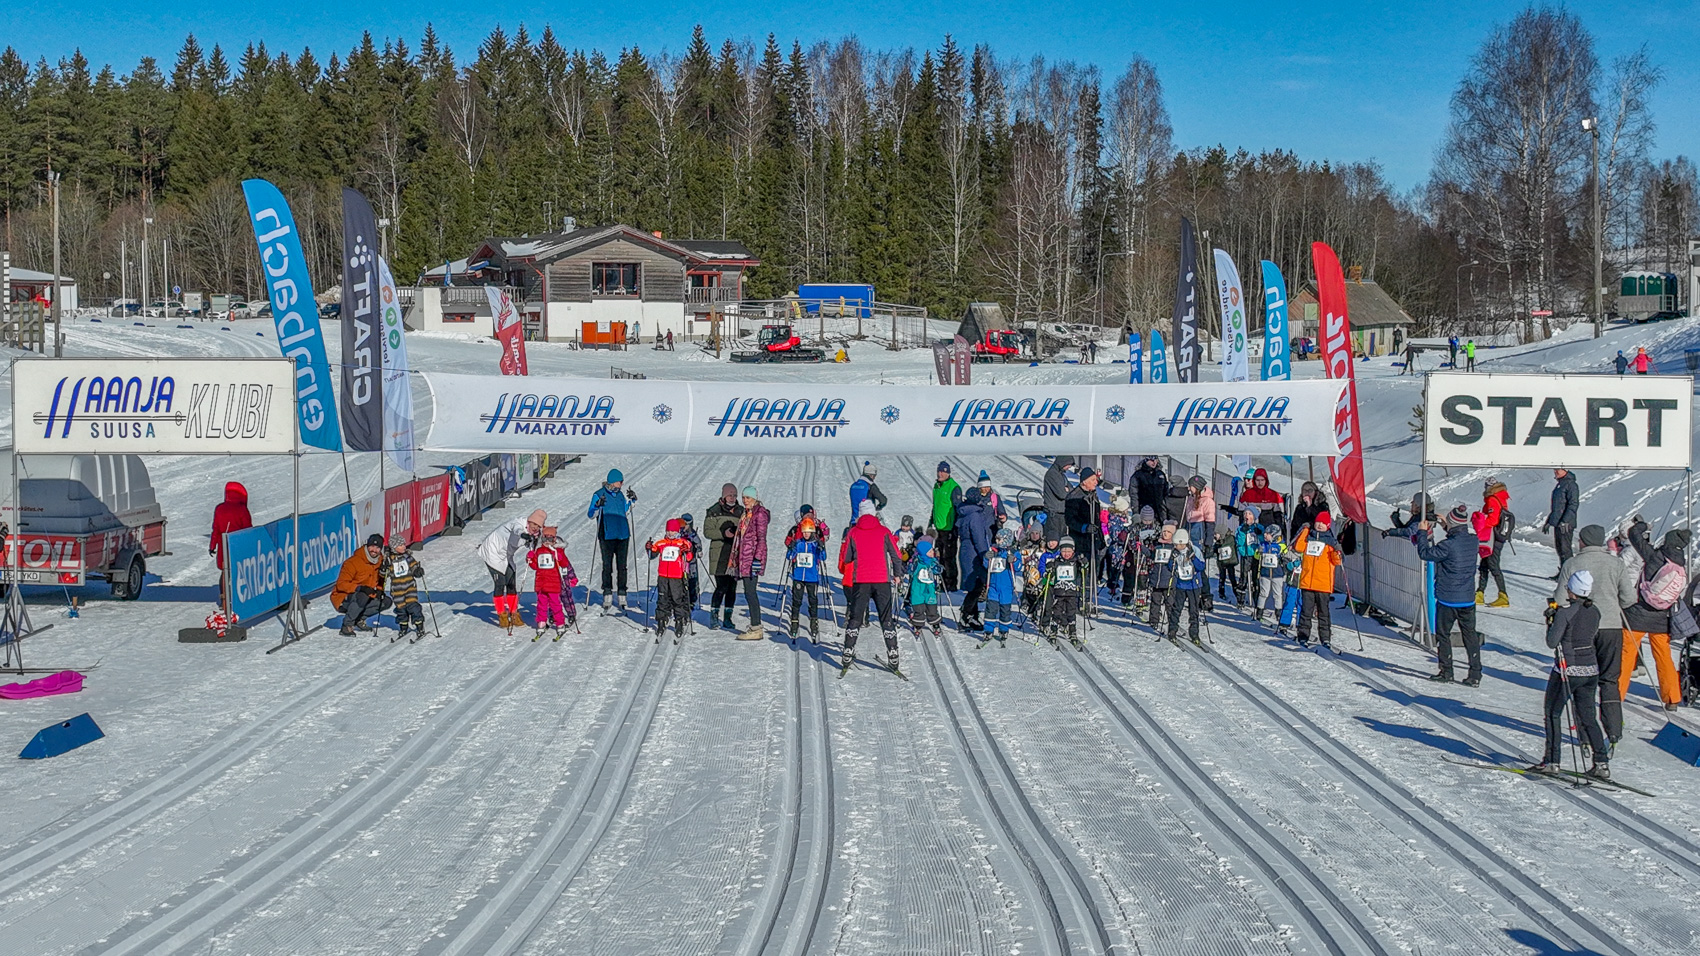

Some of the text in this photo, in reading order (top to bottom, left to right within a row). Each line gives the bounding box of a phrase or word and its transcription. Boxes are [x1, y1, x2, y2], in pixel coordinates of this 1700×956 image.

[44, 376, 273, 439] HAANJA KLUBI
[486, 393, 615, 434] HAANJA
[714, 397, 846, 437] HAANJA
[941, 397, 1071, 437] HAANJA
[1166, 396, 1291, 437] HAANJA
[1439, 394, 1679, 448] START
[90, 422, 156, 439] SUUSA
[514, 423, 608, 436] MARATON
[743, 425, 837, 438] MARATON
[970, 424, 1062, 437] MARATON
[1193, 424, 1282, 437] MARATON
[301, 514, 352, 579] embach
[236, 532, 295, 604] embach
